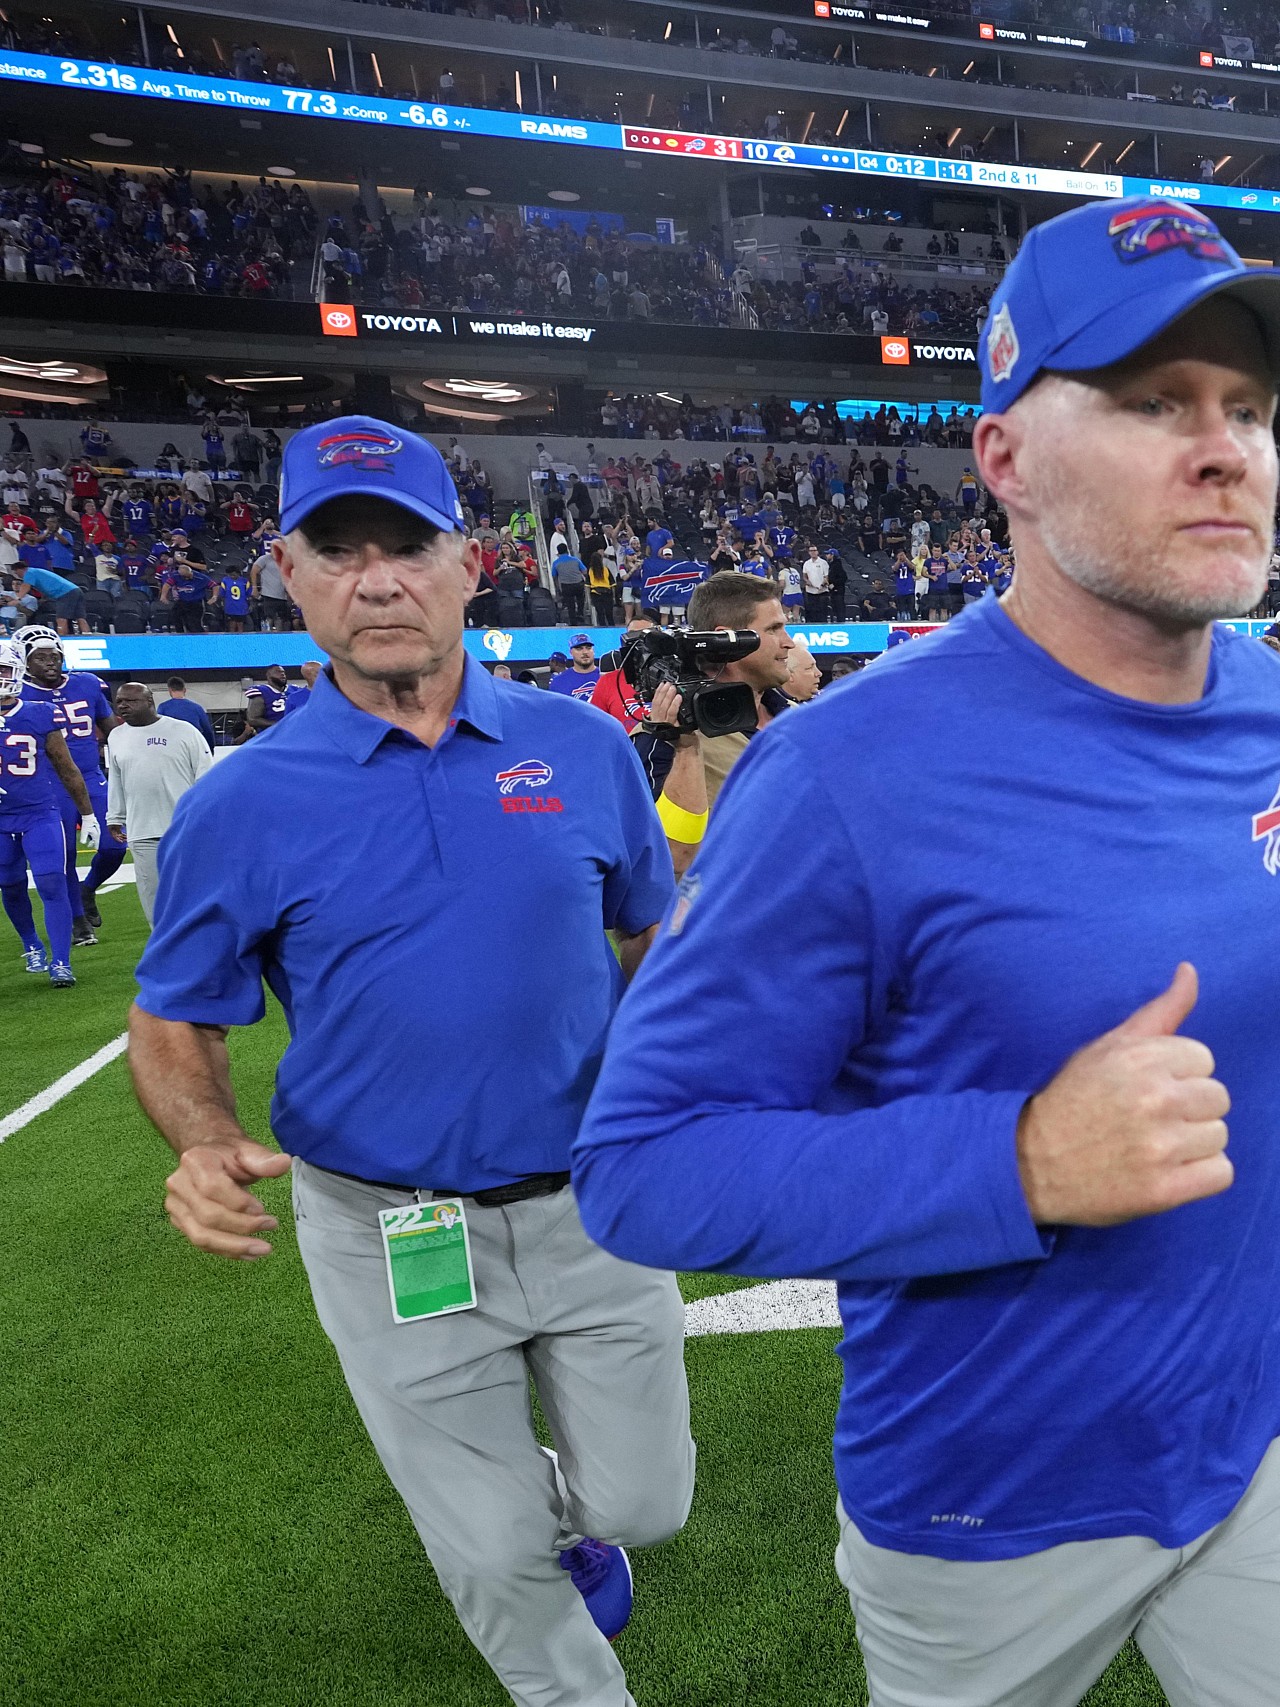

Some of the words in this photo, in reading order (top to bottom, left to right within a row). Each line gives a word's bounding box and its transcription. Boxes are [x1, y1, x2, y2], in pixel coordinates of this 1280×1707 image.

[831, 7, 865, 19] TOYOTA
[995, 30, 1026, 40] TOYOTA
[1214, 57, 1242, 67] TOYOTA
[61, 61, 137, 90] 2.31s
[143, 83, 174, 97] Avg.
[178, 86, 210, 101] Time
[211, 90, 226, 101] to
[230, 91, 270, 107] Throw
[282, 89, 337, 115] 77.3
[343, 105, 388, 121] xComp
[400, 105, 448, 128] -6.6
[521, 120, 588, 140] RAMS
[714, 139, 740, 156] 31
[744, 143, 768, 160] 10
[860, 157, 878, 169] Q4
[886, 157, 926, 176] 0:12
[979, 167, 1007, 183] 2nd
[1010, 171, 1021, 183] &
[1026, 173, 1037, 185] 11
[1066, 179, 1082, 190] Ball
[1085, 180, 1099, 191] On
[1105, 180, 1117, 192] 15
[1150, 184, 1201, 200] RAMS
[362, 314, 442, 333] TOYOTA
[470, 321, 496, 335] we
[497, 321, 540, 337] make
[541, 322, 553, 337] it
[554, 327, 593, 342] easy
[914, 344, 976, 361] TOYOTA
[77, 471, 91, 483] 17
[130, 508, 143, 520] 17
[234, 506, 245, 517] 17
[776, 534, 787, 545] 17
[128, 566, 139, 575] 17
[789, 574, 800, 585] 99
[231, 586, 241, 600] 9
[792, 631, 850, 647] AMS
[146, 737, 167, 746] BILLS
[500, 797, 564, 814] BILLS
[383, 1205, 423, 1230] 22
